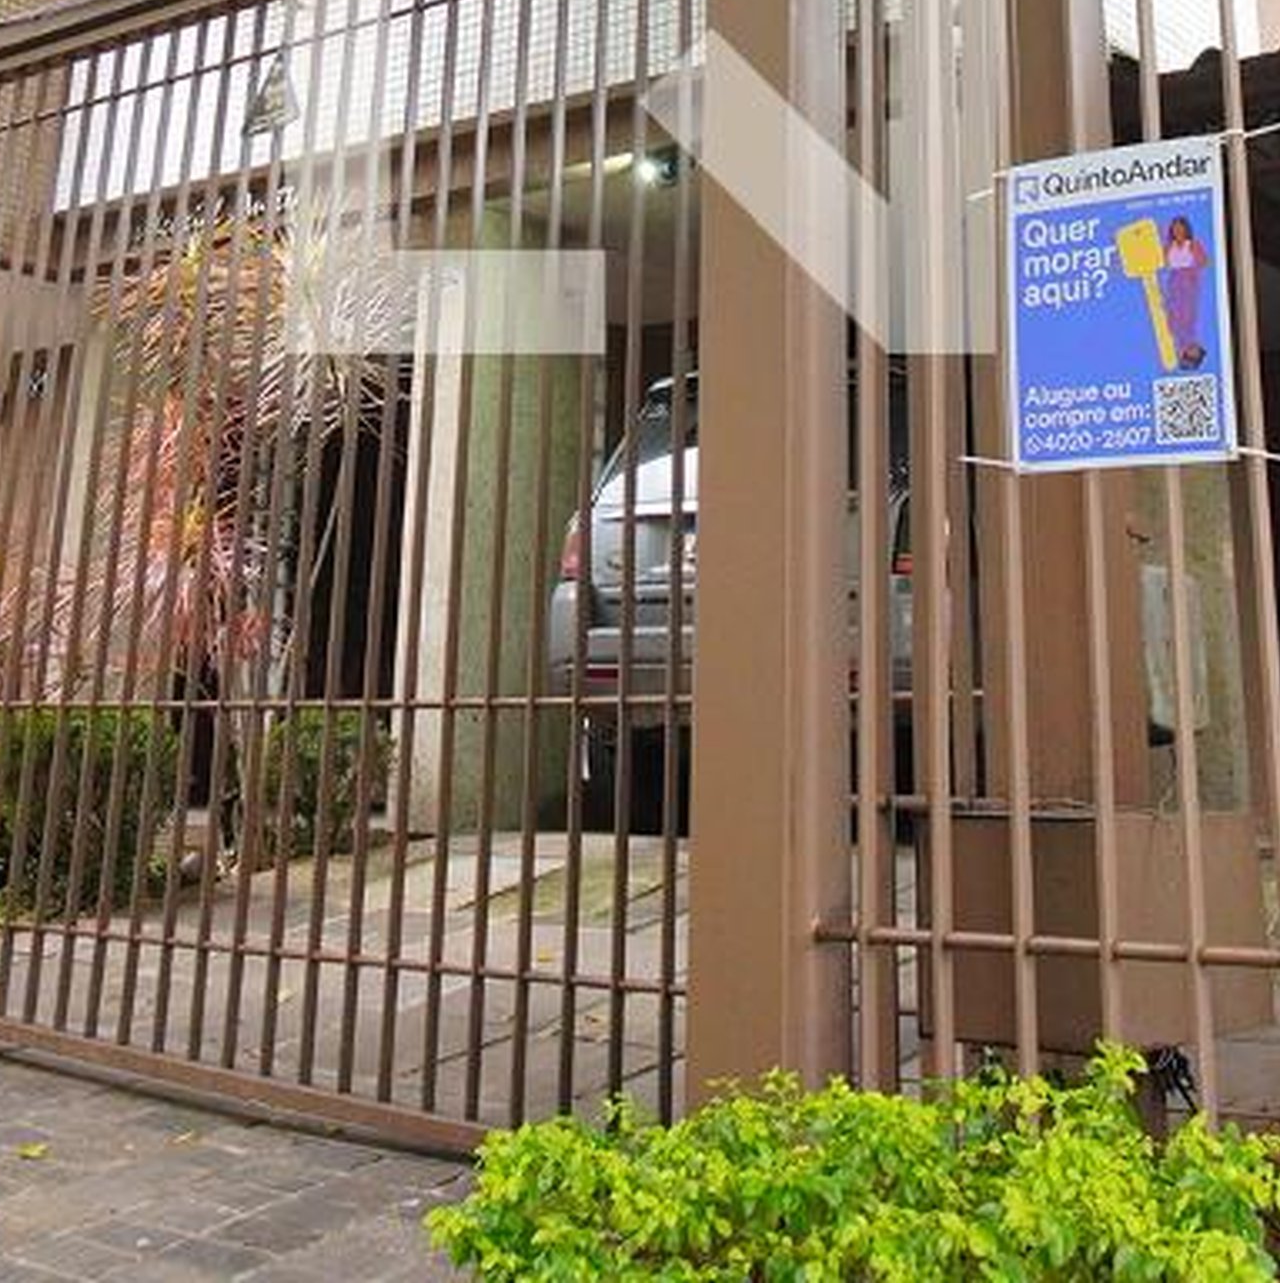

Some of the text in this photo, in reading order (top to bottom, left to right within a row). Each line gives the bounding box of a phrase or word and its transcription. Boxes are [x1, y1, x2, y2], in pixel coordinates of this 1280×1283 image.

[1043, 155, 1211, 196] QuintoAndar
[1024, 218, 1100, 248] Quer
[1025, 245, 1117, 277] morar
[1023, 269, 1109, 310] aqui?
[1024, 382, 1131, 408] Alugue ou
[1025, 403, 1151, 429] compre em:
